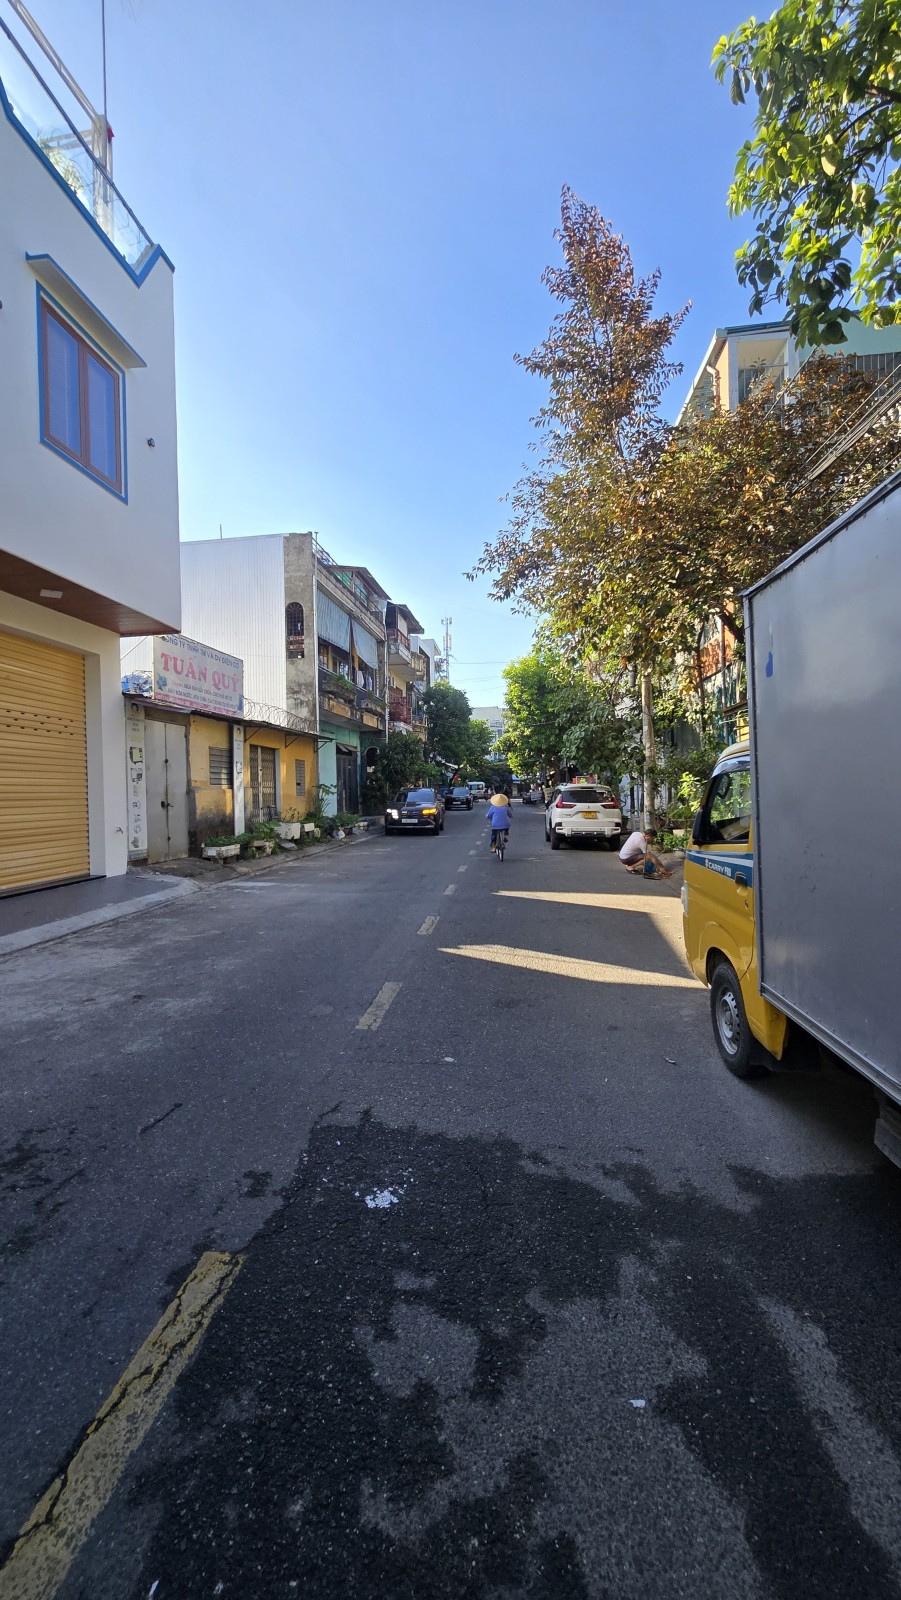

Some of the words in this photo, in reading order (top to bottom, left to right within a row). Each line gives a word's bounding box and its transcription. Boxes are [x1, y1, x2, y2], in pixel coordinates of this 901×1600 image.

[179, 640, 185, 648] TY
[160, 651, 208, 683] TUẤN
[211, 673, 239, 692] QUÝ
[708, 861, 725, 874] CARRY
